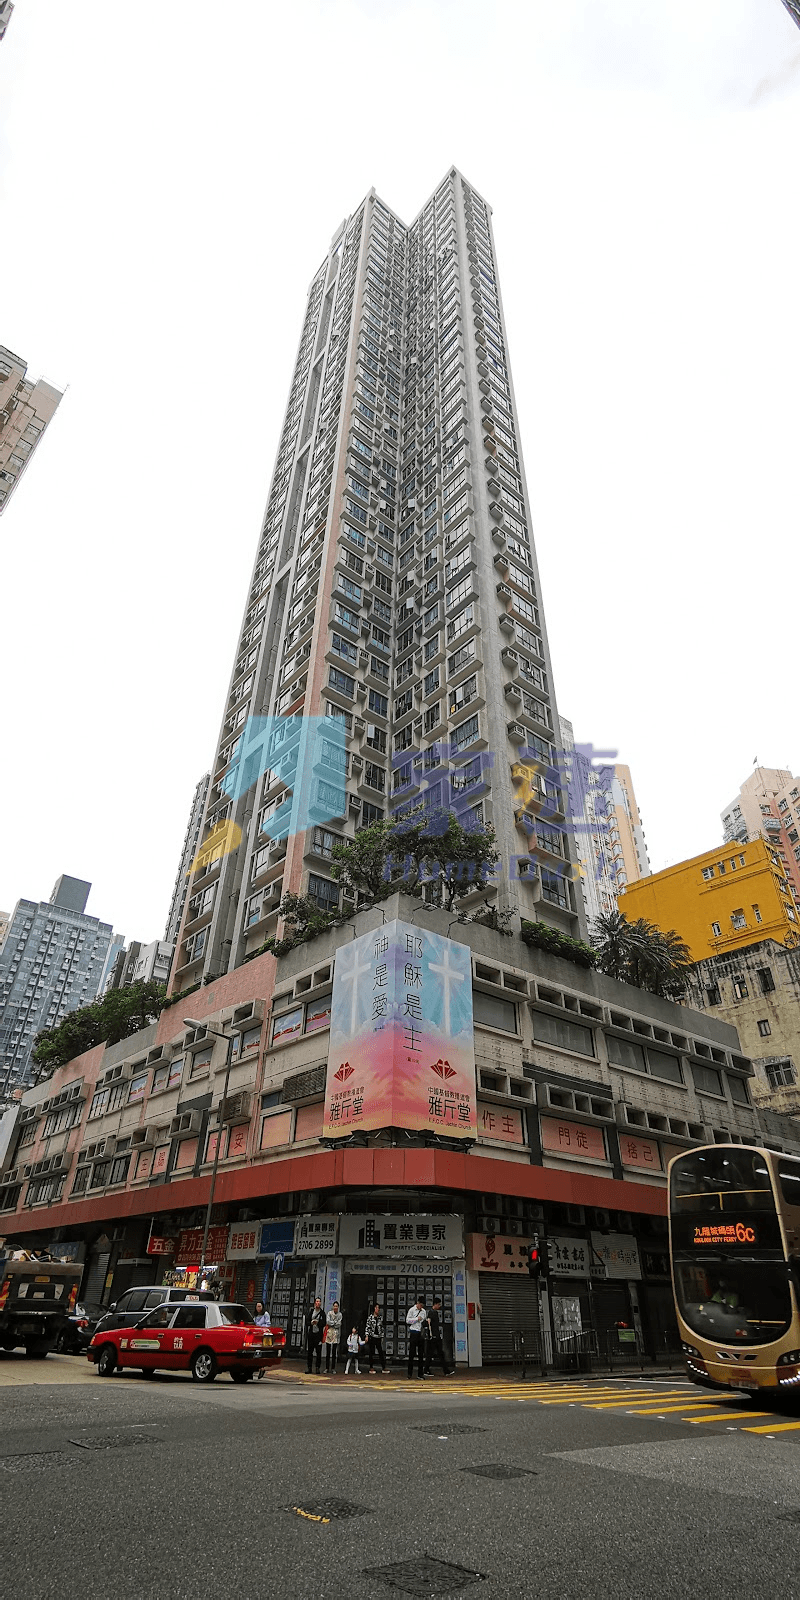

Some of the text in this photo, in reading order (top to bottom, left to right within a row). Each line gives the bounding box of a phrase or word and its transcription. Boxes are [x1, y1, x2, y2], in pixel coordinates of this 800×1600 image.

[371, 934, 389, 1021] 神是愛
[402, 933, 423, 1053] 耶穌是主
[428, 1095, 471, 1123] 雅斤堂
[558, 1126, 589, 1150] 門徒
[383, 1223, 446, 1241] 置業專家
[694, 1225, 735, 1237] 九龍城碼頭
[735, 1222, 755, 1242] 6C
[151, 1238, 175, 1252] 五金
[298, 1239, 334, 1250] 2706 2899
[400, 1263, 450, 1274] 2706 2899
